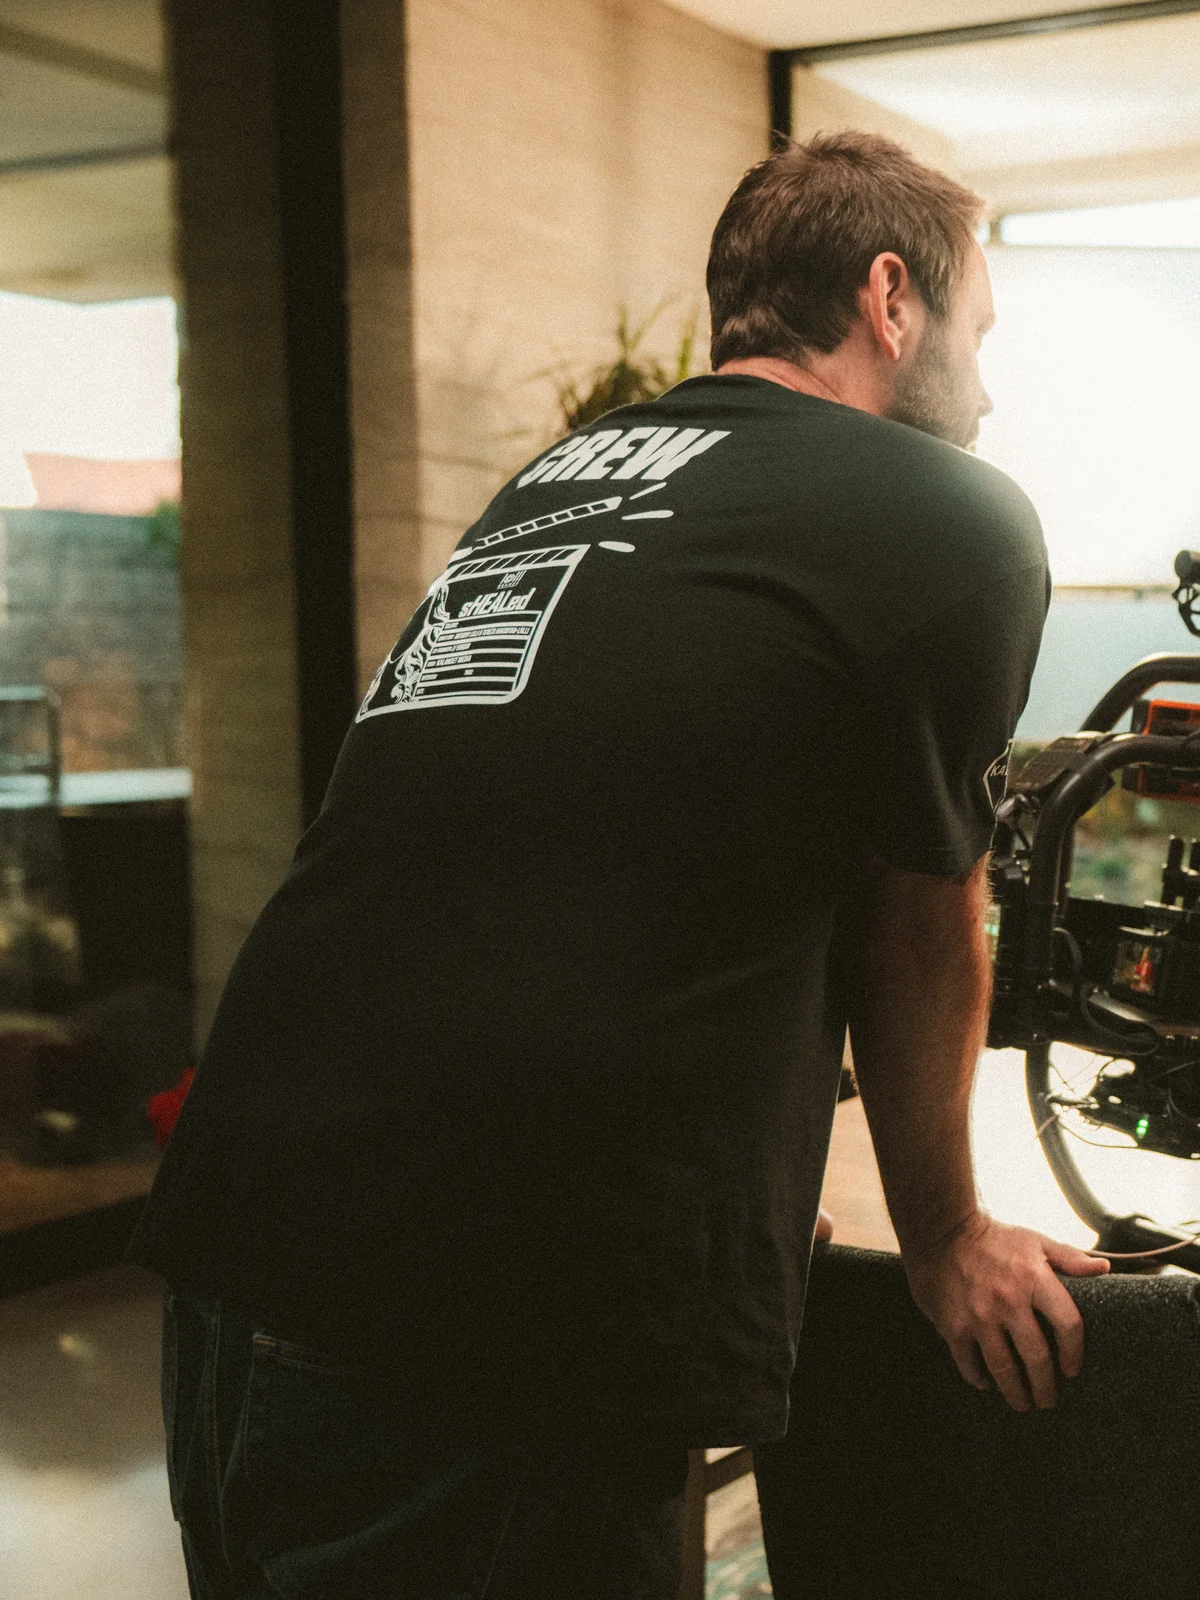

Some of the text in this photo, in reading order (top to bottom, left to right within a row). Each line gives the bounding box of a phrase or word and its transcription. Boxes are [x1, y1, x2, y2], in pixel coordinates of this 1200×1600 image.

[516, 426, 732, 489] CREW
[458, 587, 537, 618] sHEALed
[990, 764, 1007, 776] KA
